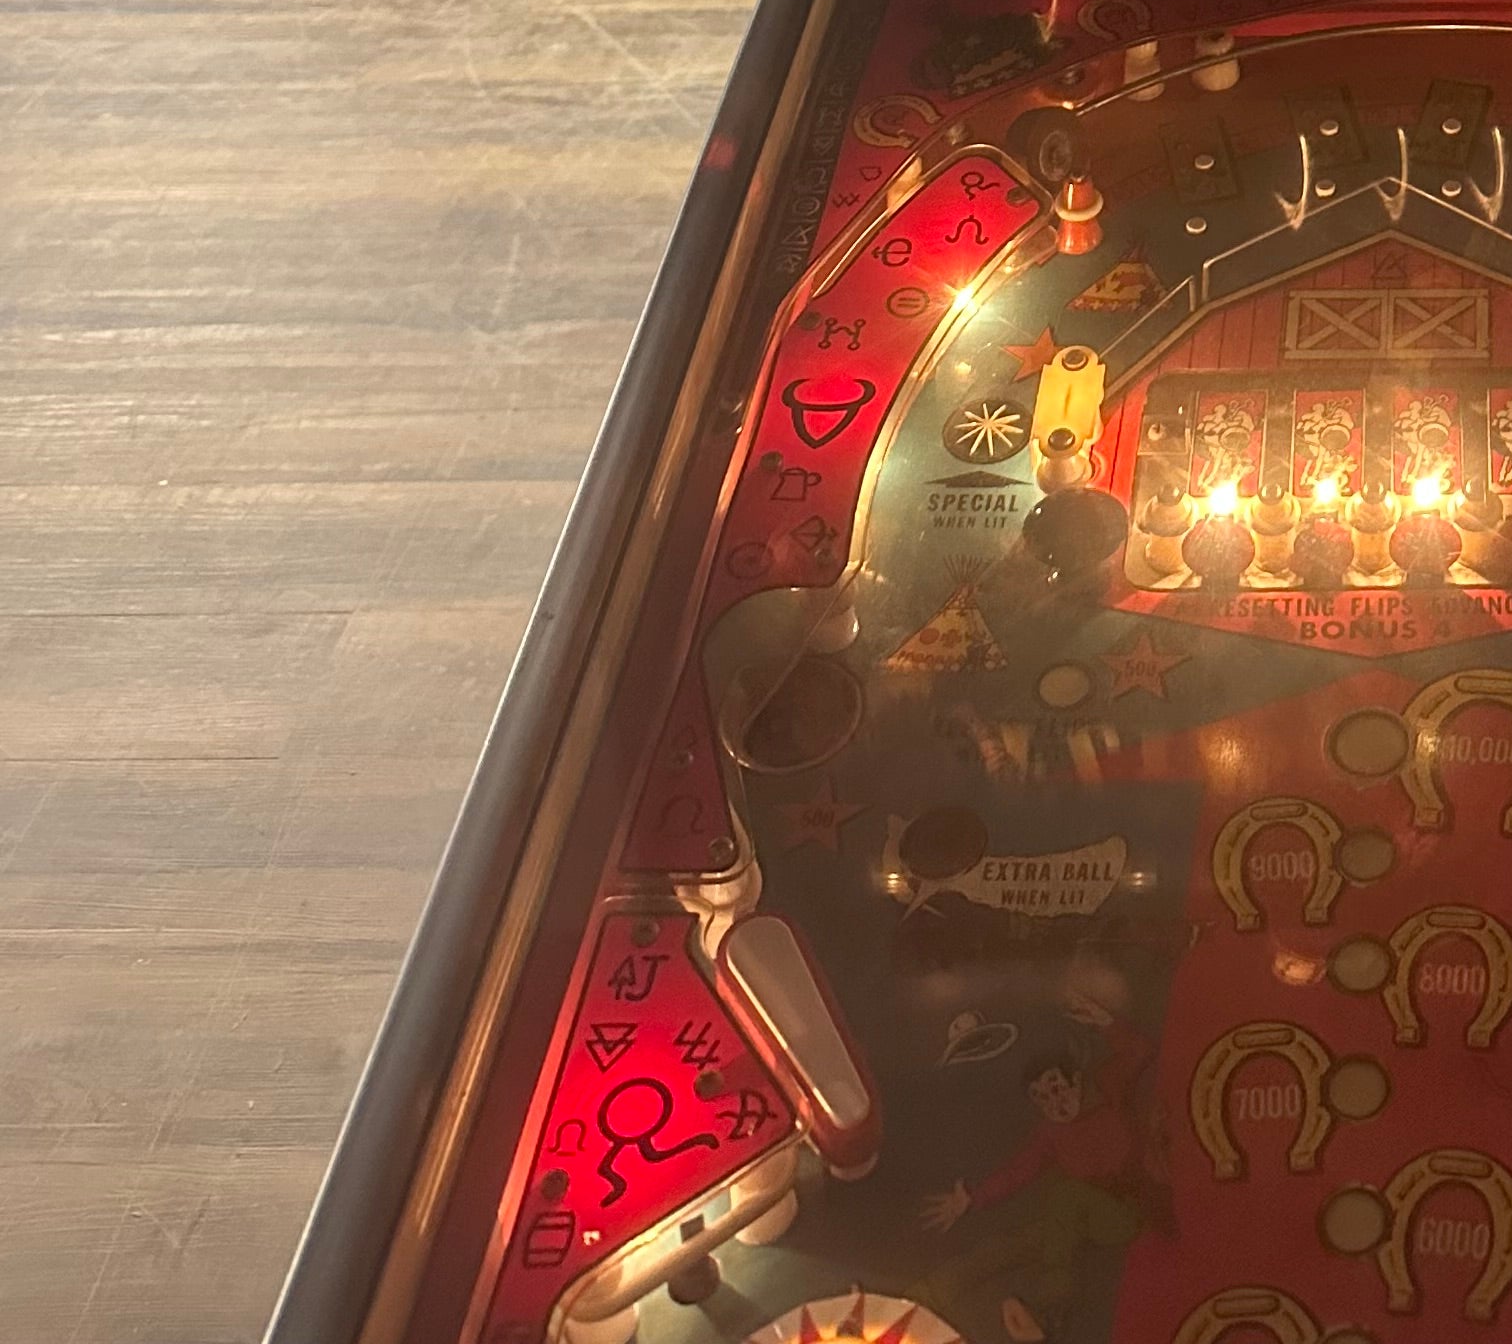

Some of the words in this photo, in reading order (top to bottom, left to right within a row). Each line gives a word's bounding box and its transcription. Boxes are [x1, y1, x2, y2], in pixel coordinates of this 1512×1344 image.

[927, 493, 1020, 513] SPECIAL
[933, 515, 976, 529] WHEN
[984, 515, 1009, 529] LIT
[1351, 596, 1413, 616] FLIPS
[1300, 620, 1418, 640] BONUS
[1123, 660, 1159, 678] 500
[982, 862, 1050, 882] EXTRA
[1062, 862, 1114, 882] BALL
[1001, 889, 1049, 905] WHEN
[1058, 889, 1085, 905] LIT
[1418, 963, 1487, 995] 8000
[1233, 1084, 1299, 1120] 7000
[1419, 1217, 1491, 1261] 6000
